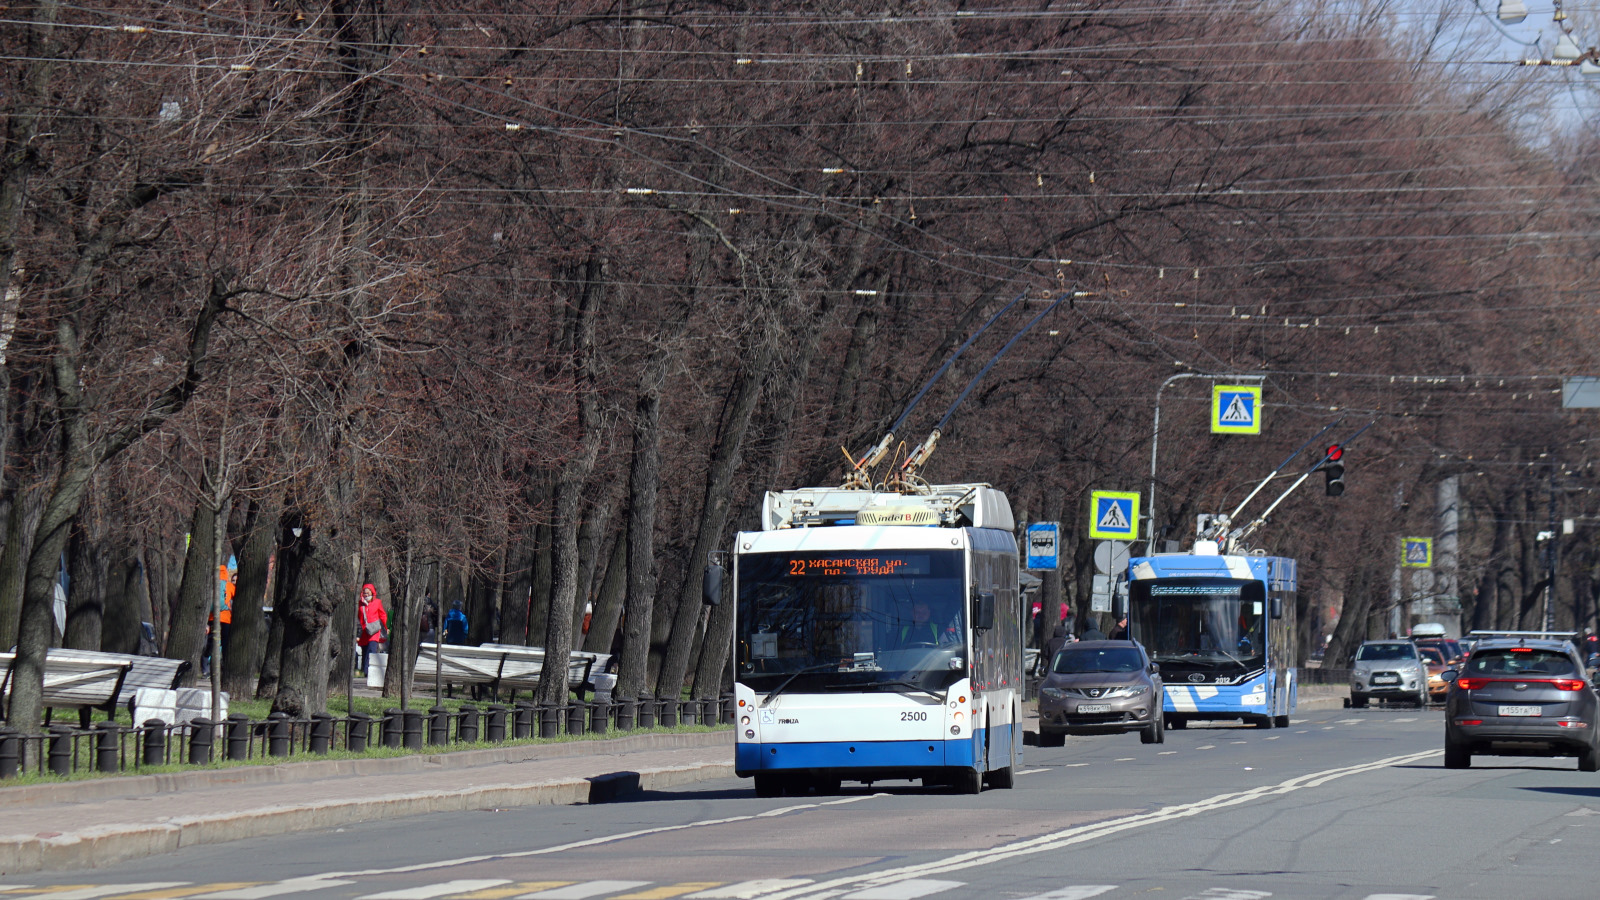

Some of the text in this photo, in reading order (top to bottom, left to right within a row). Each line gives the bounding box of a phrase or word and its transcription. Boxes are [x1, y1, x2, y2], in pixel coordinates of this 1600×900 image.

[878, 513, 911, 522] indel B
[789, 559, 806, 575] 22
[808, 558, 879, 568] ХАСАНСКАЯ
[856, 566, 895, 575] ТРУДА
[900, 711, 928, 721] 2500
